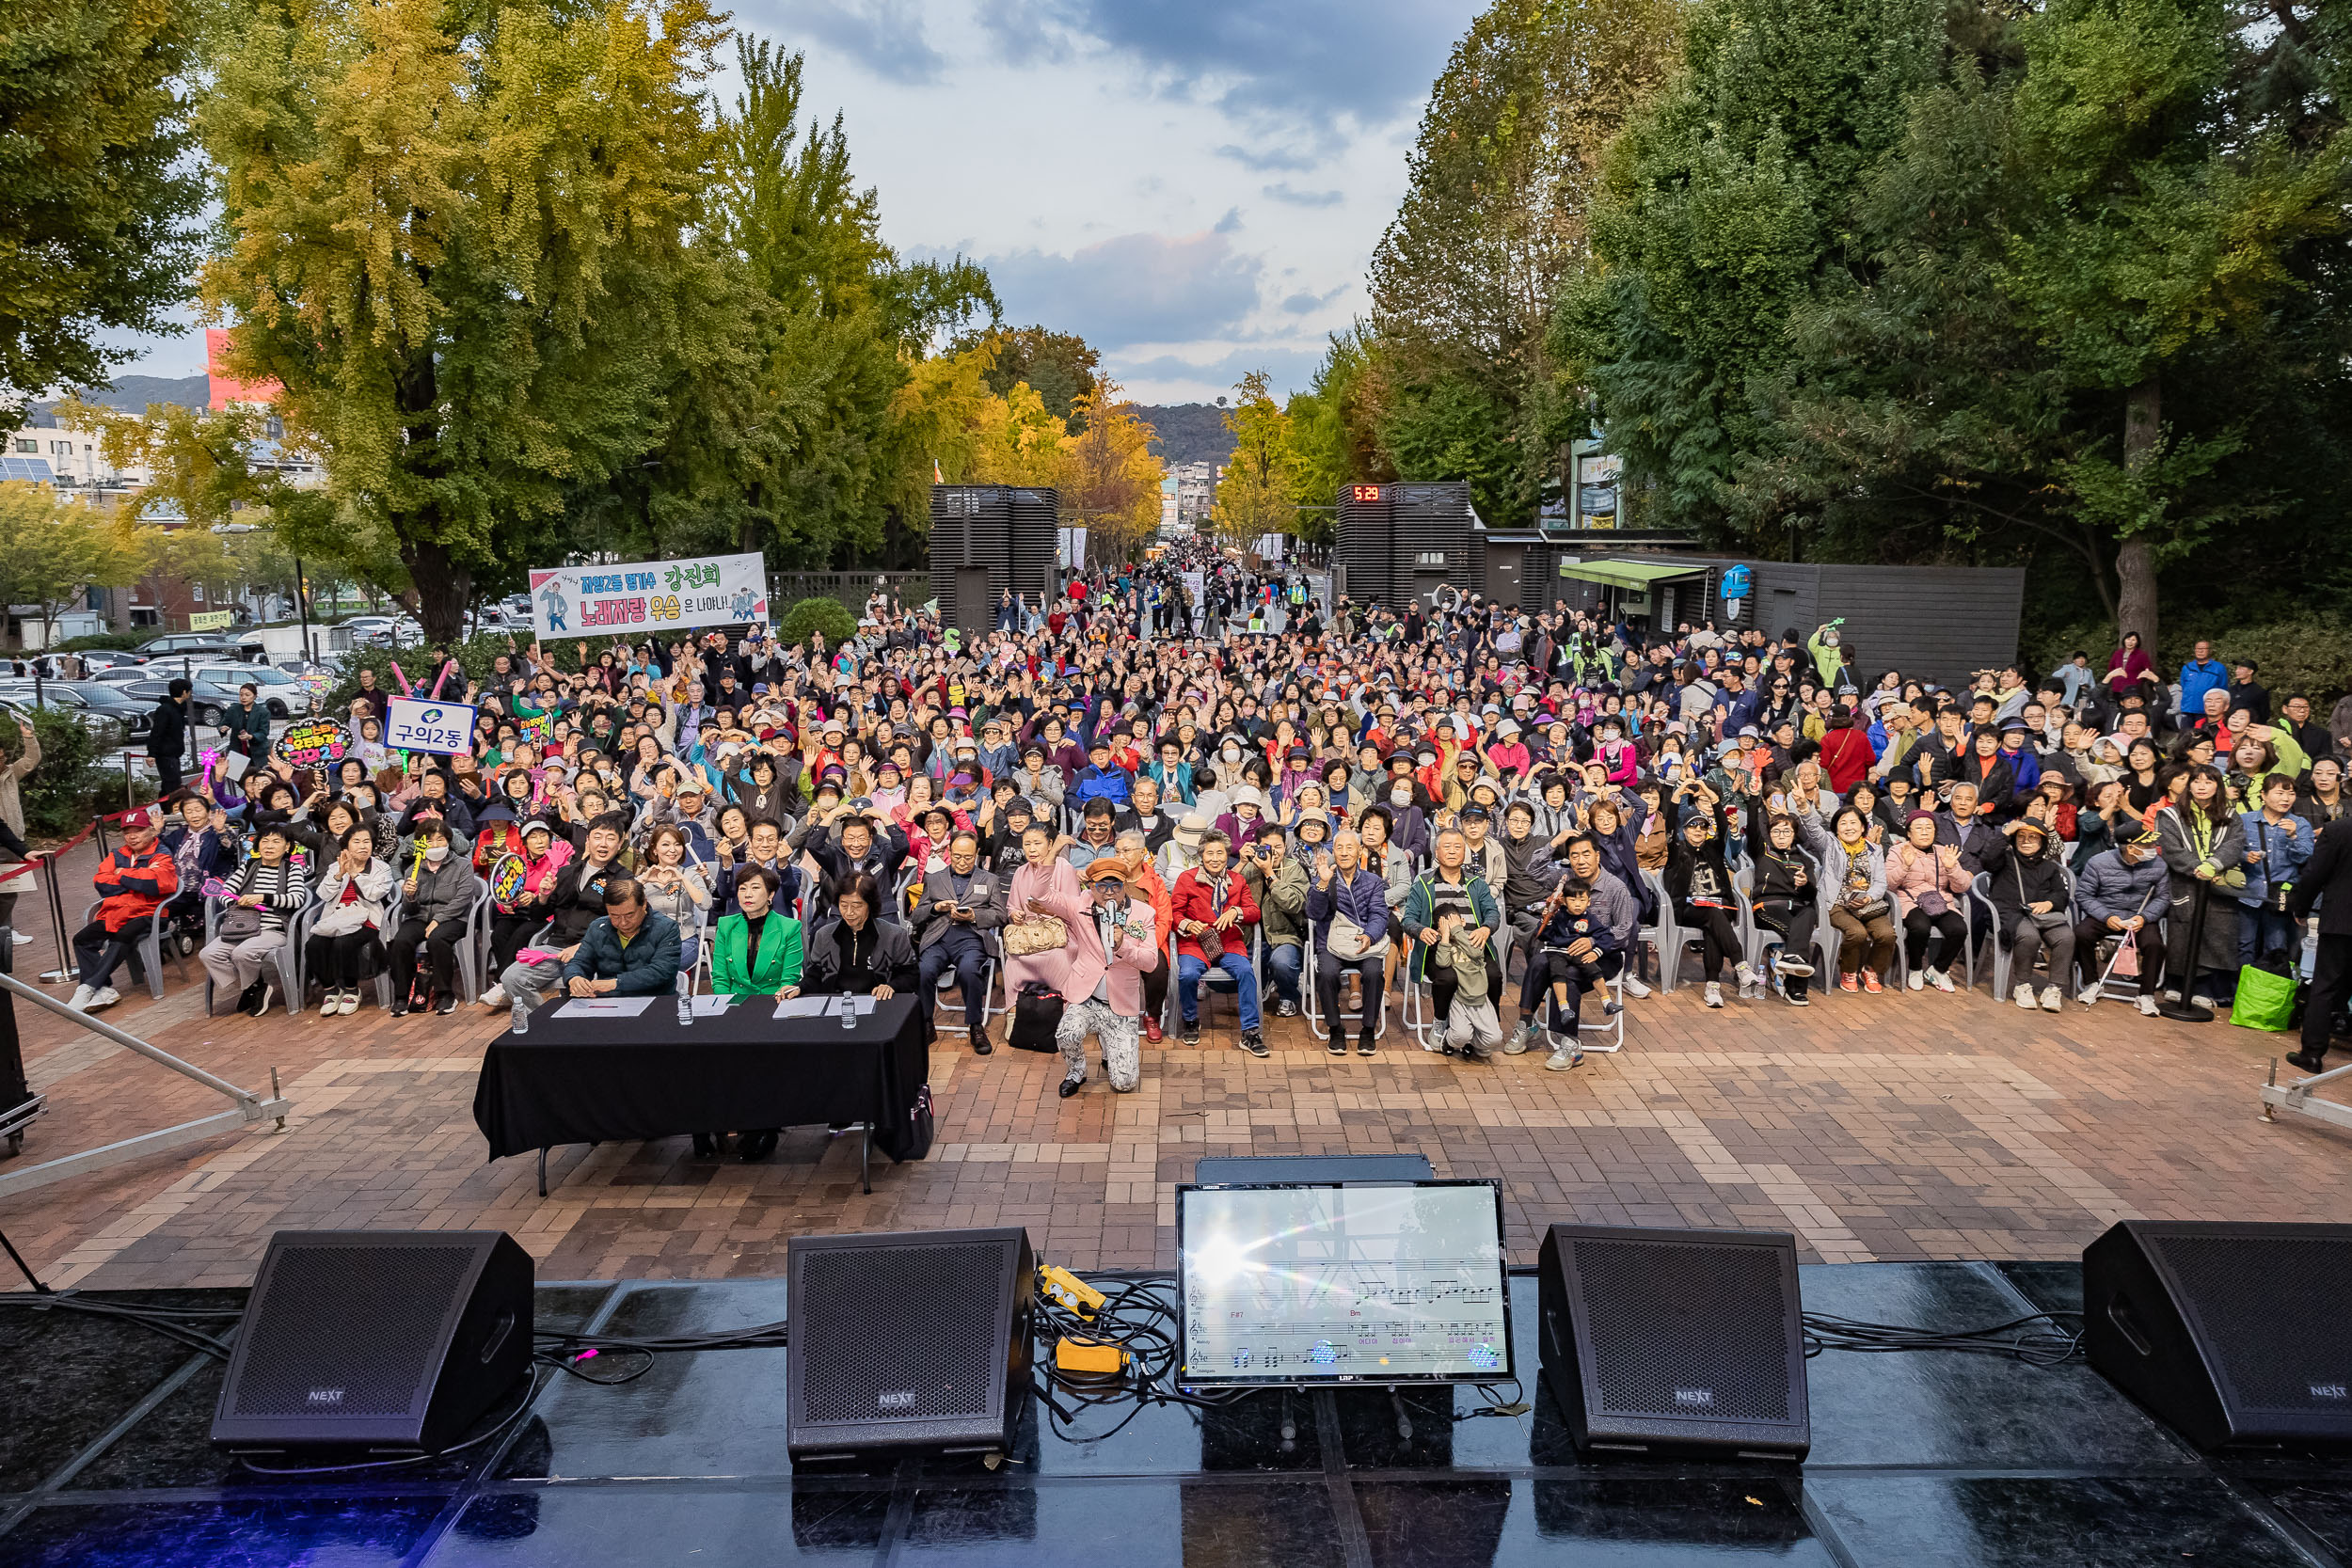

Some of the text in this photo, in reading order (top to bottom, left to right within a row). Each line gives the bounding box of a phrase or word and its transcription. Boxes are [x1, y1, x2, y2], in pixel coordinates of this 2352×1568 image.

[580, 562, 721, 594] 자양2동 명가수 강진희
[580, 594, 728, 626] 노래자랑 우승 은 나야나!
[293, 724, 332, 739] 슈퍼스타
[395, 724, 463, 748] 구의2동
[289, 742, 345, 766] 구의2동
[125, 813, 138, 823] N
[309, 1388, 343, 1402] NEXT
[879, 1391, 914, 1406] NEXT
[1676, 1389, 1711, 1404] NEXT
[2310, 1384, 2346, 1399] NEXT
